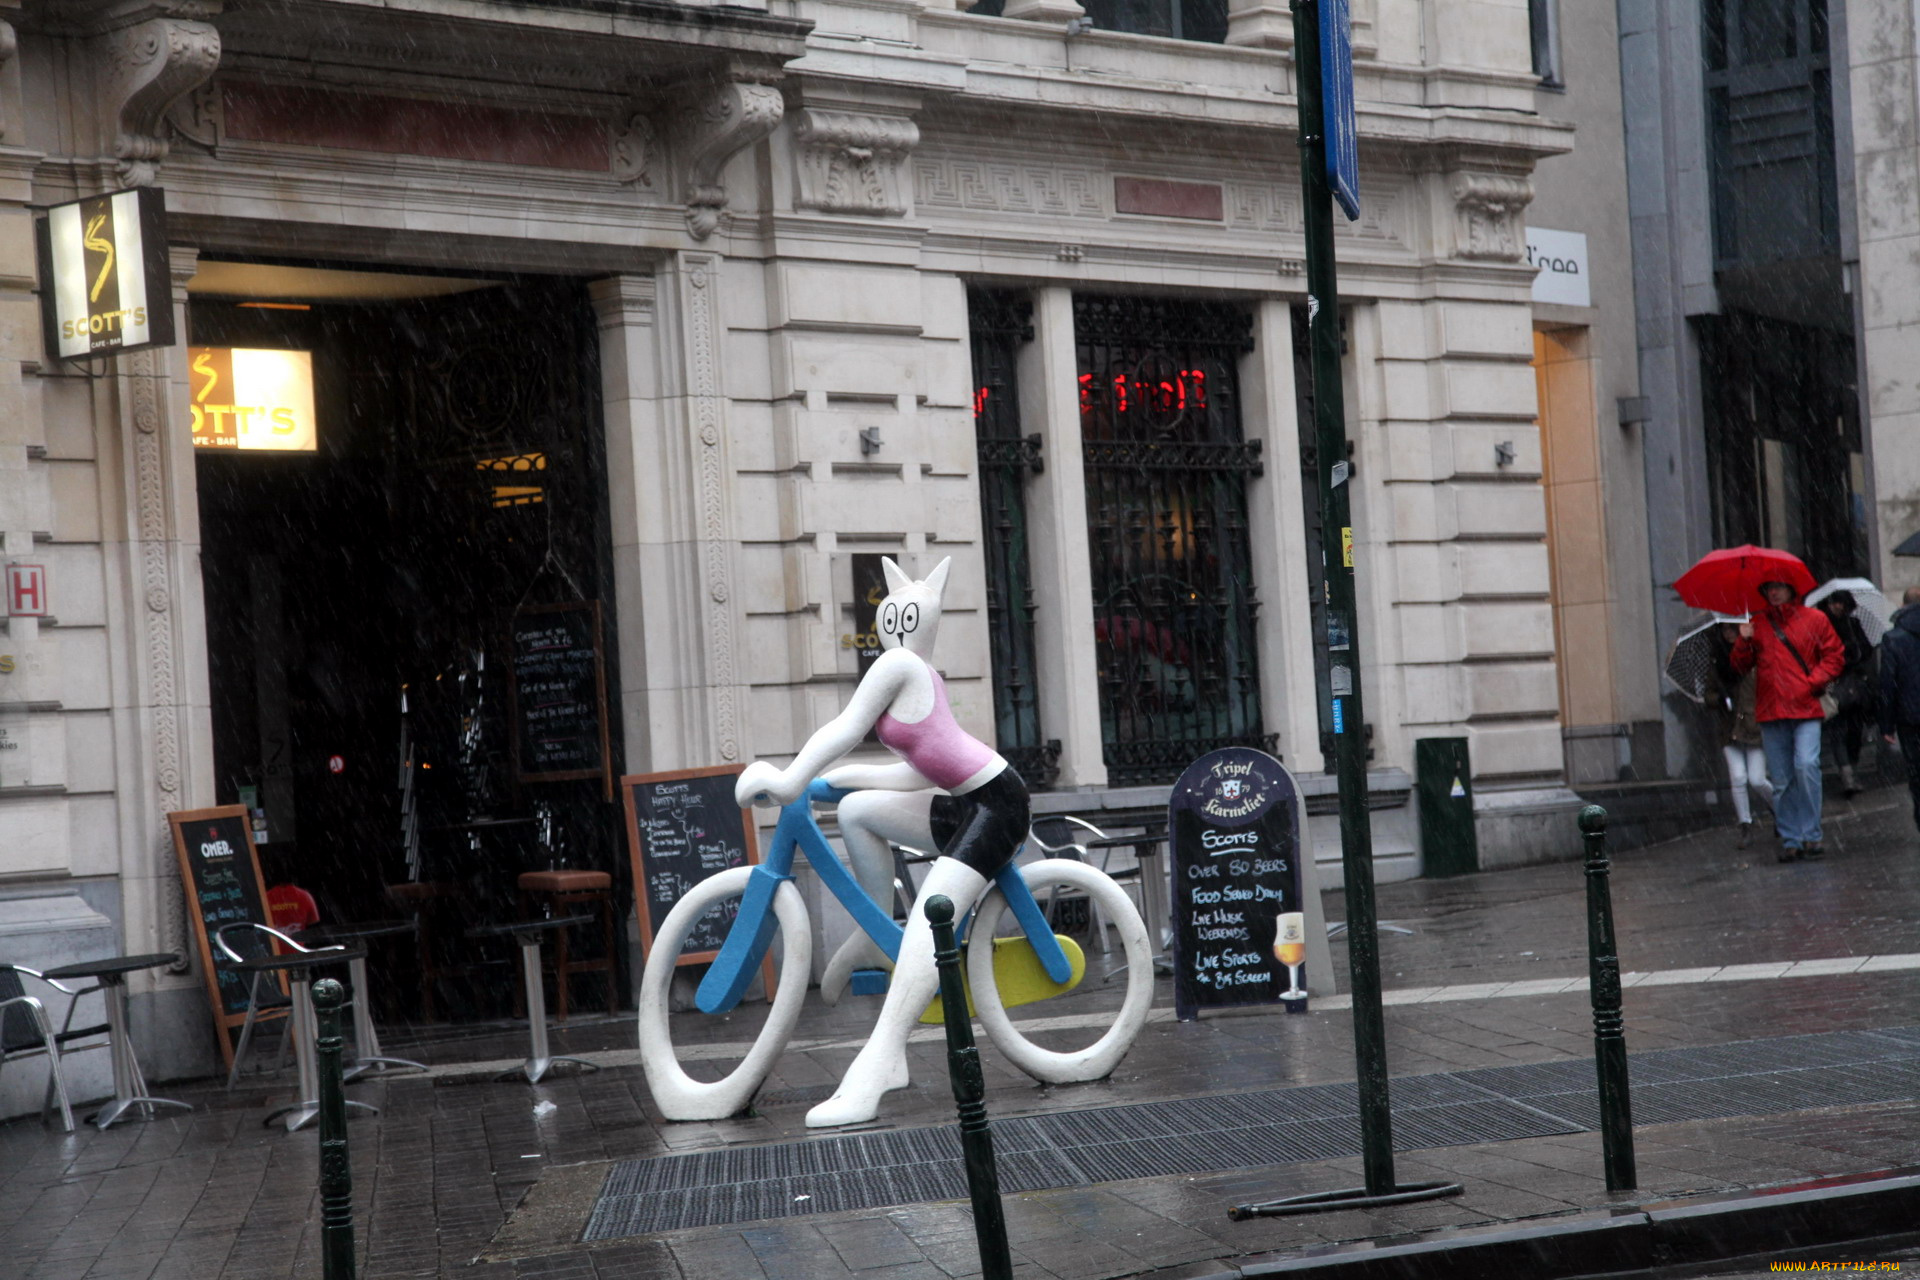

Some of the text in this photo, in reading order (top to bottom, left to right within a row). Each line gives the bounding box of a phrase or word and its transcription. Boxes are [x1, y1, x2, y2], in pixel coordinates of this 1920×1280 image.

[62, 307, 146, 339] SCOTT'S
[109, 338, 122, 346] BAR
[216, 437, 236, 446] BAR
[13, 571, 39, 610] H
[1211, 761, 1254, 778] Tripel
[1205, 792, 1266, 817] Karmeliet
[1229, 859, 1249, 876] 80
